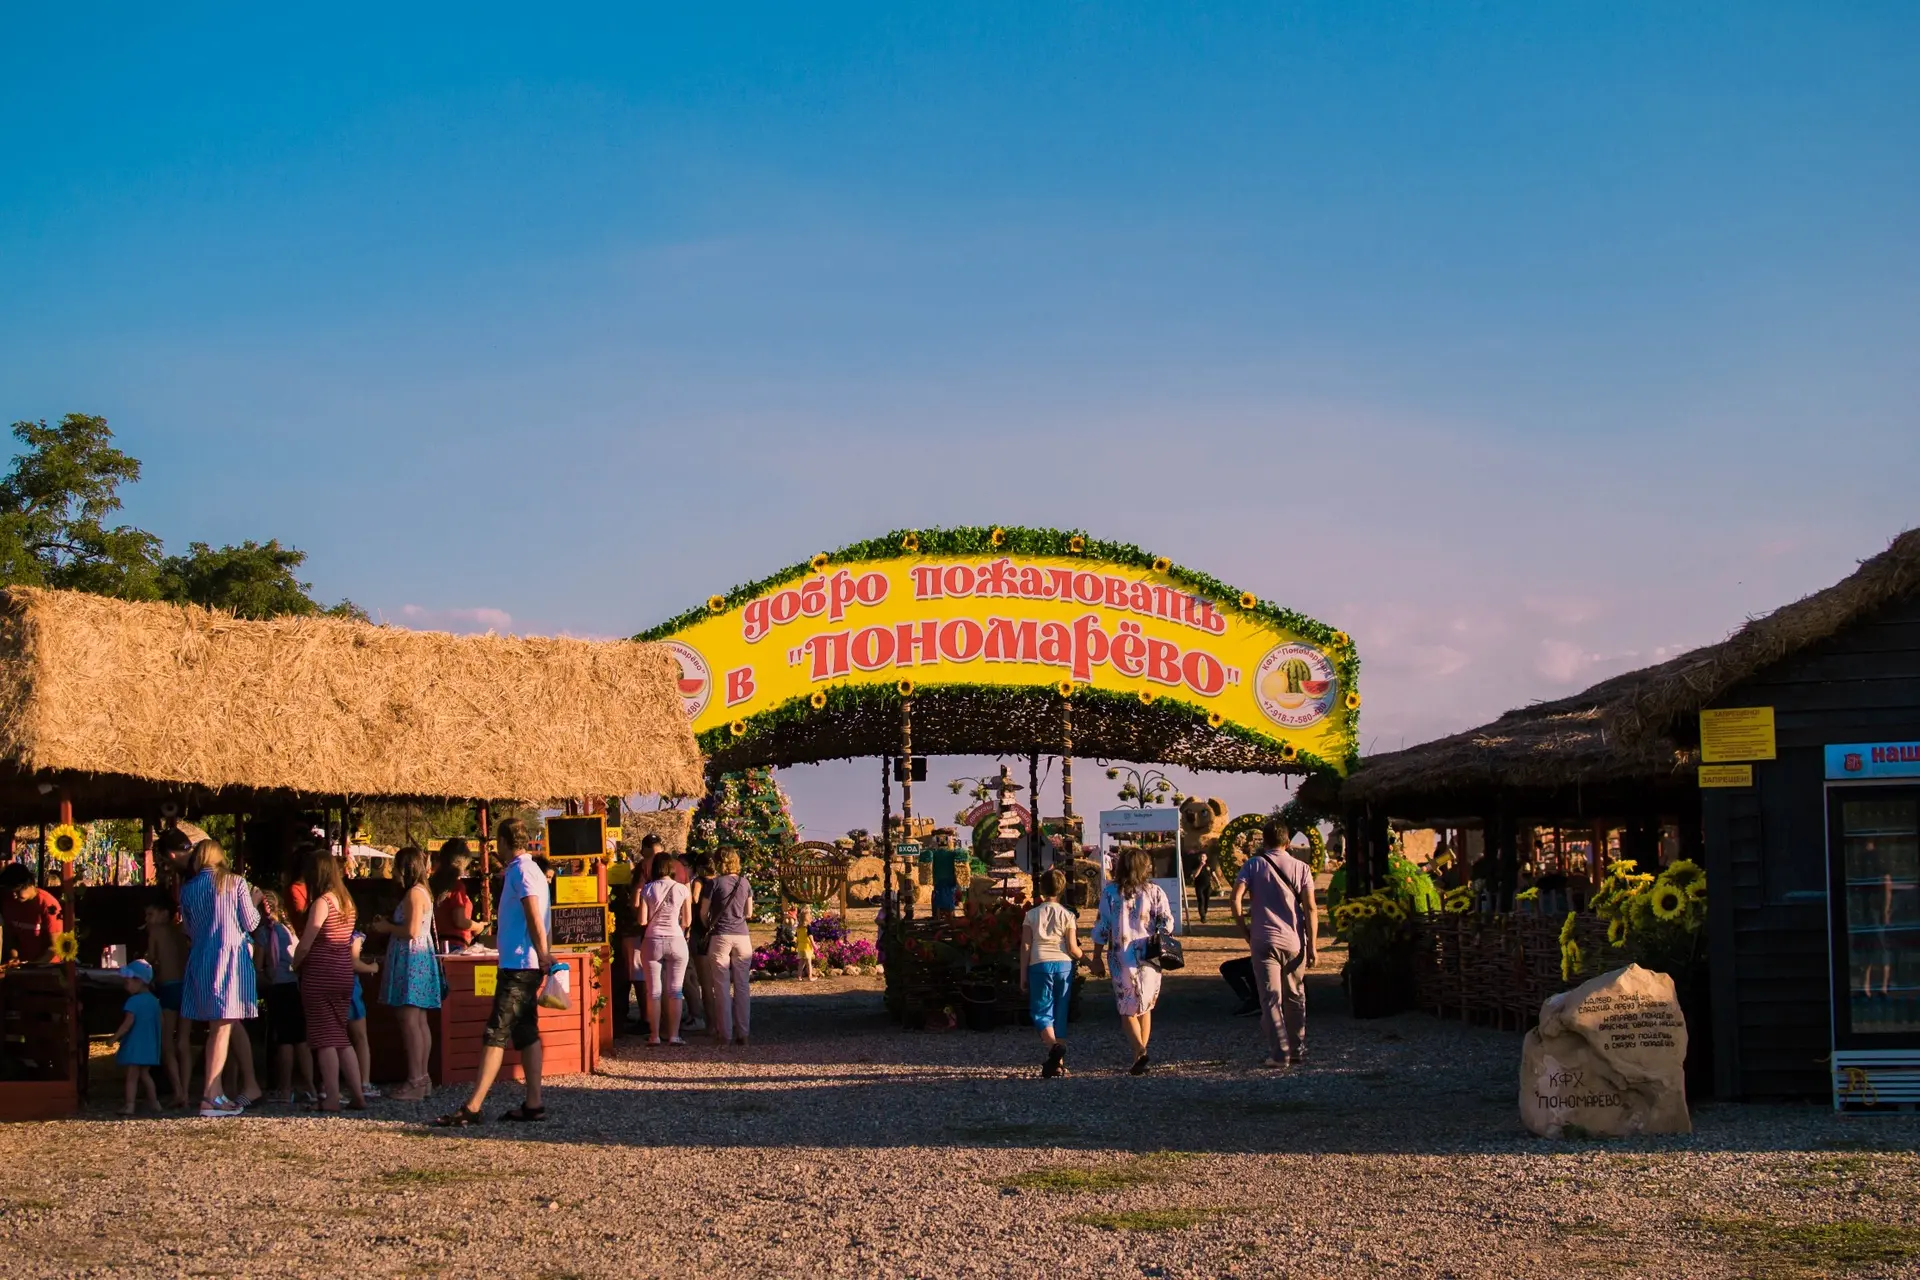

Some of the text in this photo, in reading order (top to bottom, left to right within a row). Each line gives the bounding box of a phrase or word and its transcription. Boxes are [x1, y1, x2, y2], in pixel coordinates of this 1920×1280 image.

[744, 557, 1226, 641] добро пожаловать
[1262, 654, 1279, 671] КФХ
[726, 665, 756, 706] в
[1614, 1002, 1635, 1011] АРБУЗ
[1603, 1013, 1638, 1023] НАПРАВО
[1549, 1072, 1585, 1088] КФХ
